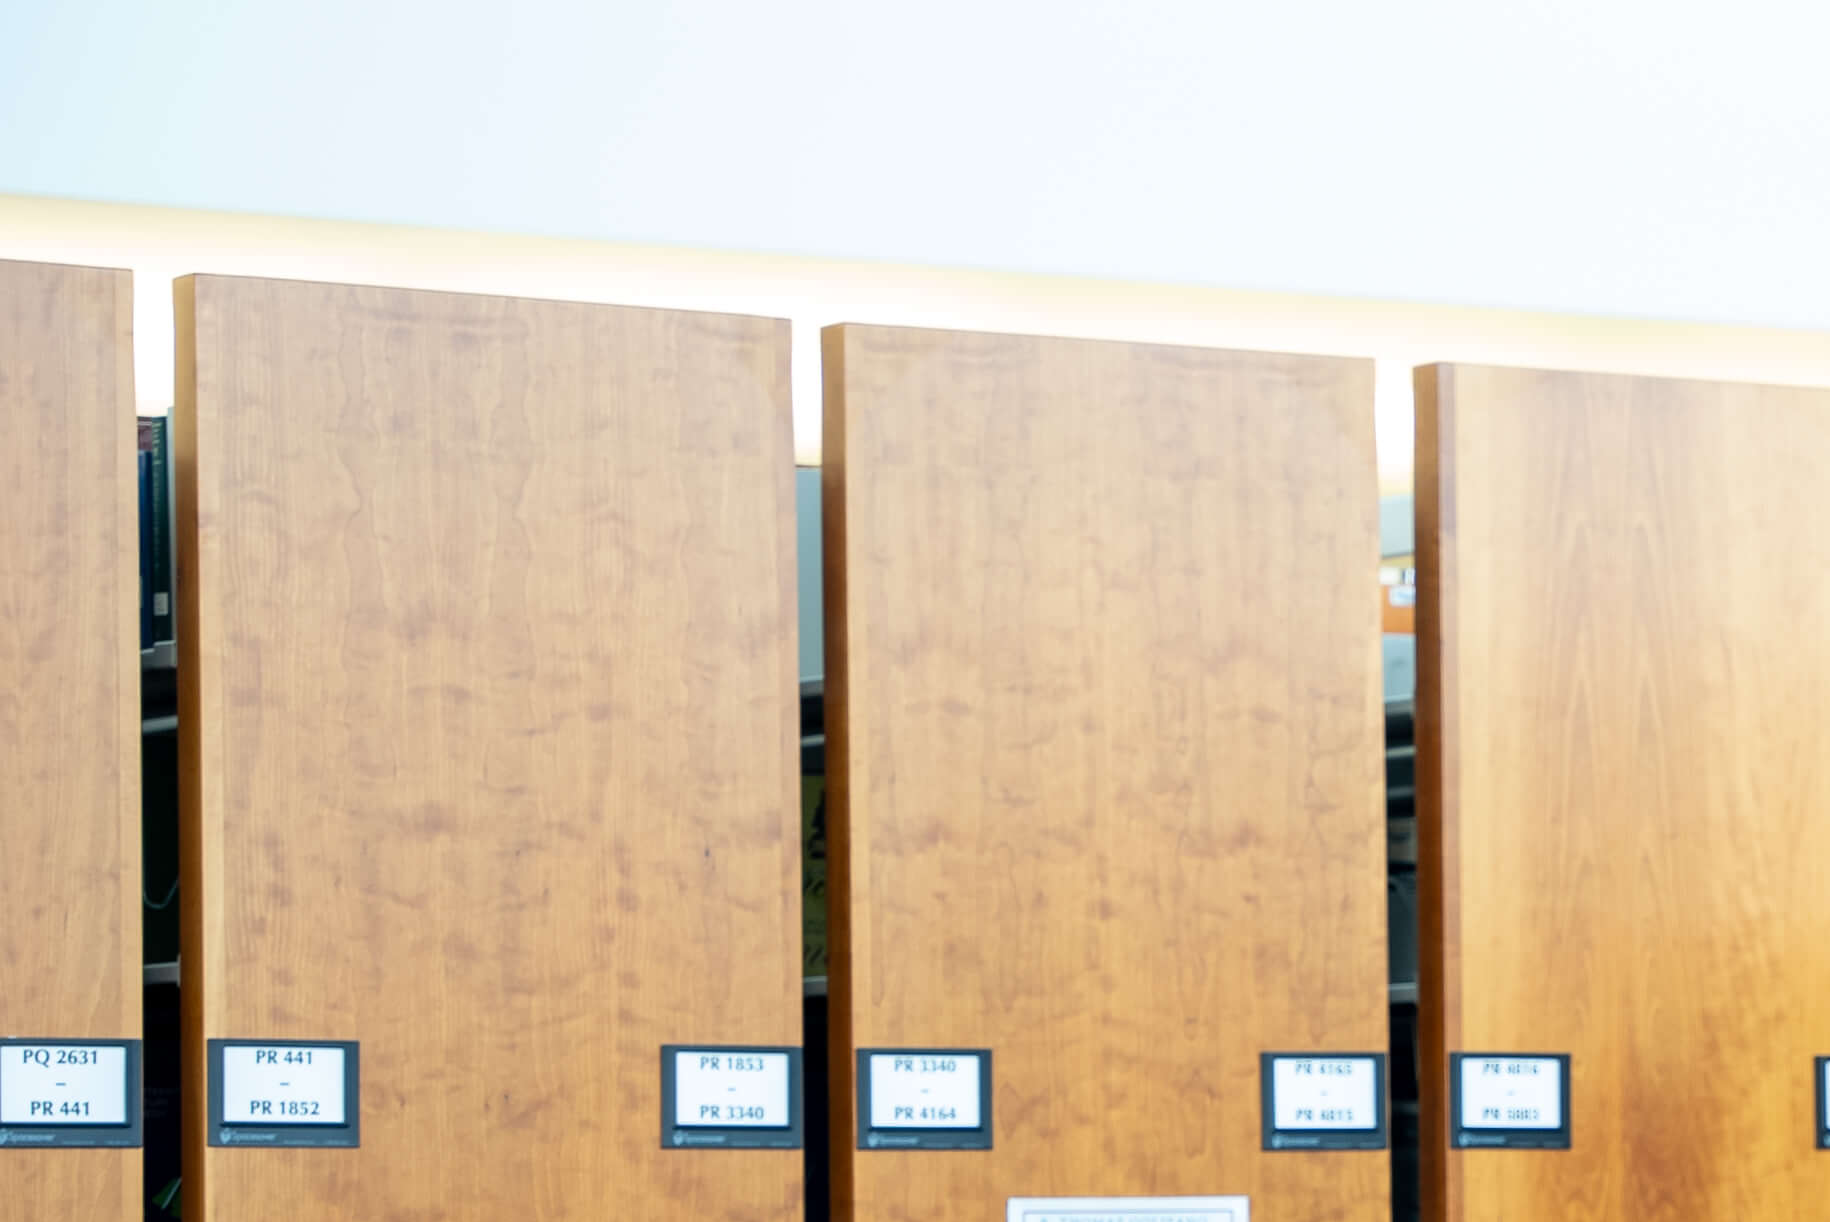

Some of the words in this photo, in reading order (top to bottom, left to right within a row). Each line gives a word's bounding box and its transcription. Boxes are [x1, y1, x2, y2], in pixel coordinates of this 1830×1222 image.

[23, 1049, 50, 1068] PQ
[57, 1050, 98, 1065] 2631
[256, 1050, 278, 1064] PR
[284, 1050, 313, 1065] 441
[700, 1056, 721, 1070] PR
[727, 1057, 764, 1071] 1853
[894, 1059, 913, 1072] PR
[31, 1101, 54, 1116] PR
[60, 1101, 90, 1116] 441
[250, 1100, 272, 1115] PR
[279, 1101, 320, 1116] 1852
[700, 1105, 720, 1119] PR
[727, 1106, 765, 1120] 3340
[894, 1106, 913, 1120] PR
[920, 1107, 956, 1120] 4164
